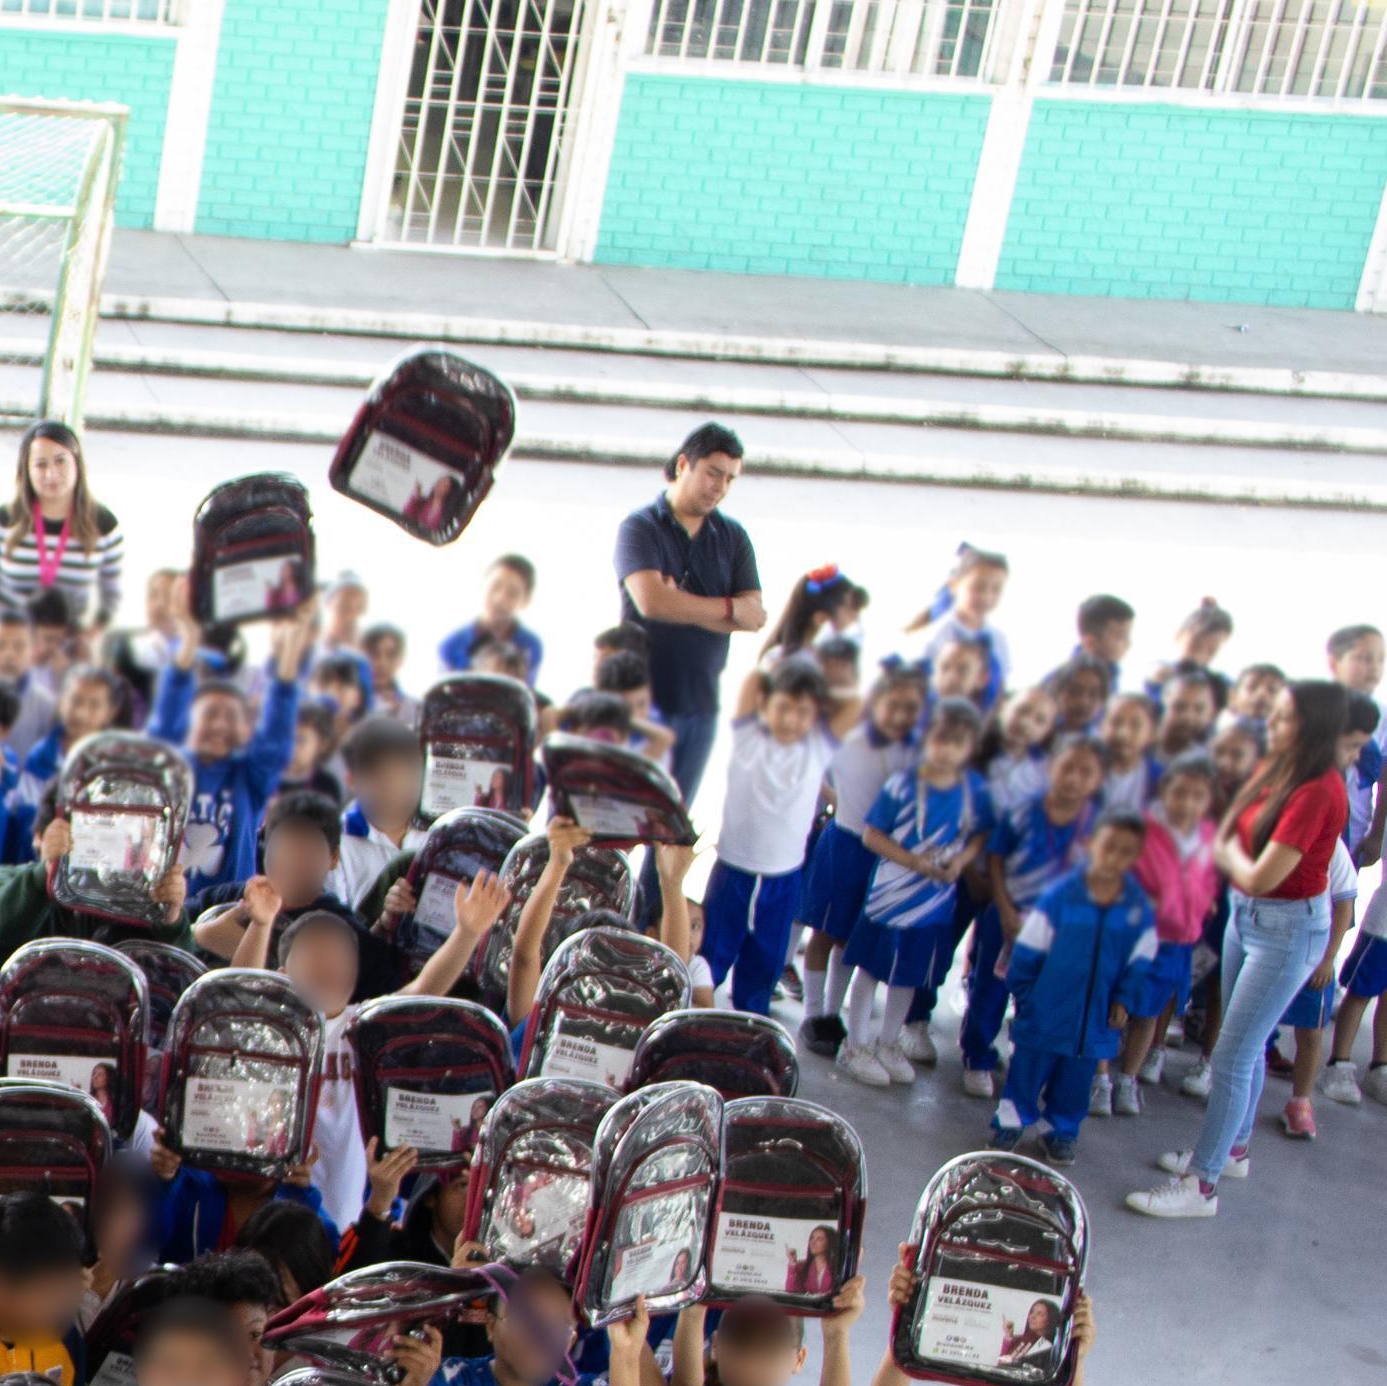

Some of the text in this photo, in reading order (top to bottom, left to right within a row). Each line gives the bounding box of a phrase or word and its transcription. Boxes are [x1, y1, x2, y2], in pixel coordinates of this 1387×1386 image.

[560, 1039, 596, 1055] BRENDA
[20, 1060, 57, 1068] BRENDA
[399, 1094, 435, 1105] BRENDA
[729, 1219, 770, 1231] BRENDA
[725, 1229, 774, 1240] VELÁZQUEZ
[943, 1284, 988, 1299] BRENDA
[938, 1296, 992, 1310] VELÁZQUEZ
